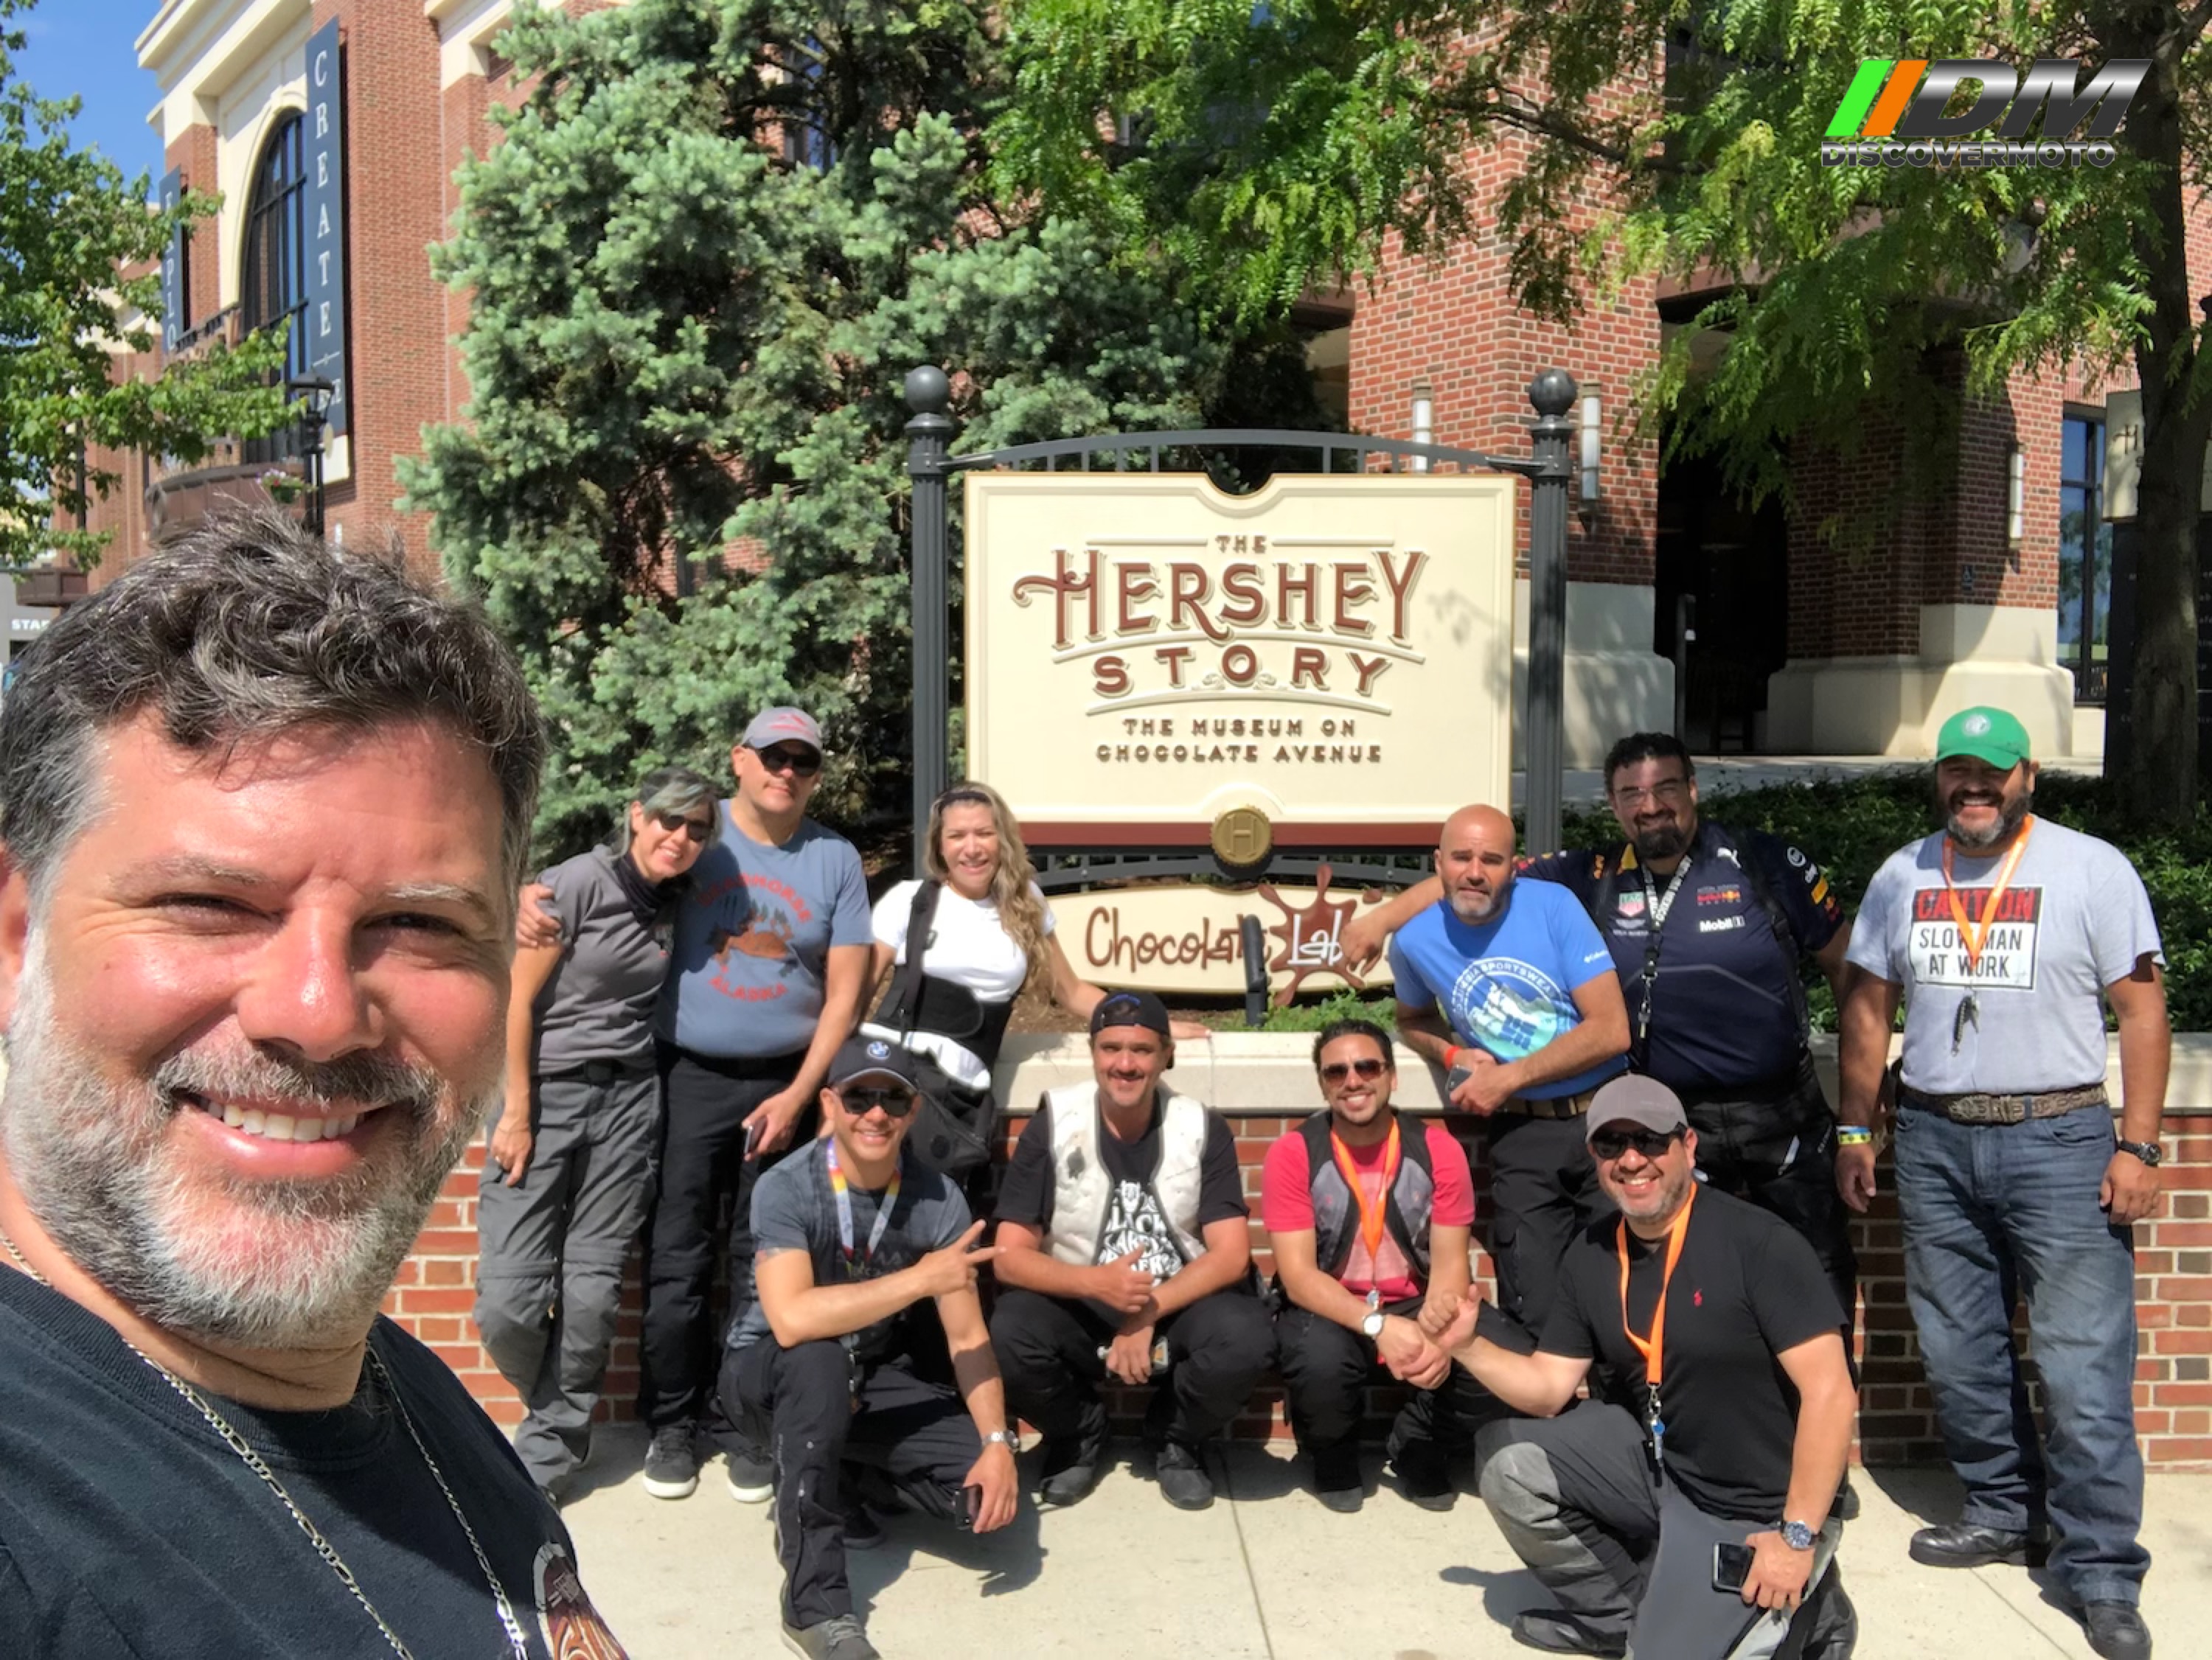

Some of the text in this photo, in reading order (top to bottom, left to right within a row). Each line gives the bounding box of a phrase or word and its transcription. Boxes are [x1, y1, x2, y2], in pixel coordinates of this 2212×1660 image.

[314, 49, 331, 337] CREATE
[1215, 534, 1267, 554] THE
[1011, 548, 1429, 649] HERSHEY
[1093, 644, 1391, 697] STORY
[1122, 719, 1355, 738] THE MUSEUM ON
[1096, 744, 1382, 764] CHOCOLATE AVENUE
[1085, 906, 1344, 974] Chocolat Lab
[1929, 953, 2009, 977] AT WORK
[708, 974, 789, 1003] ALASKA
